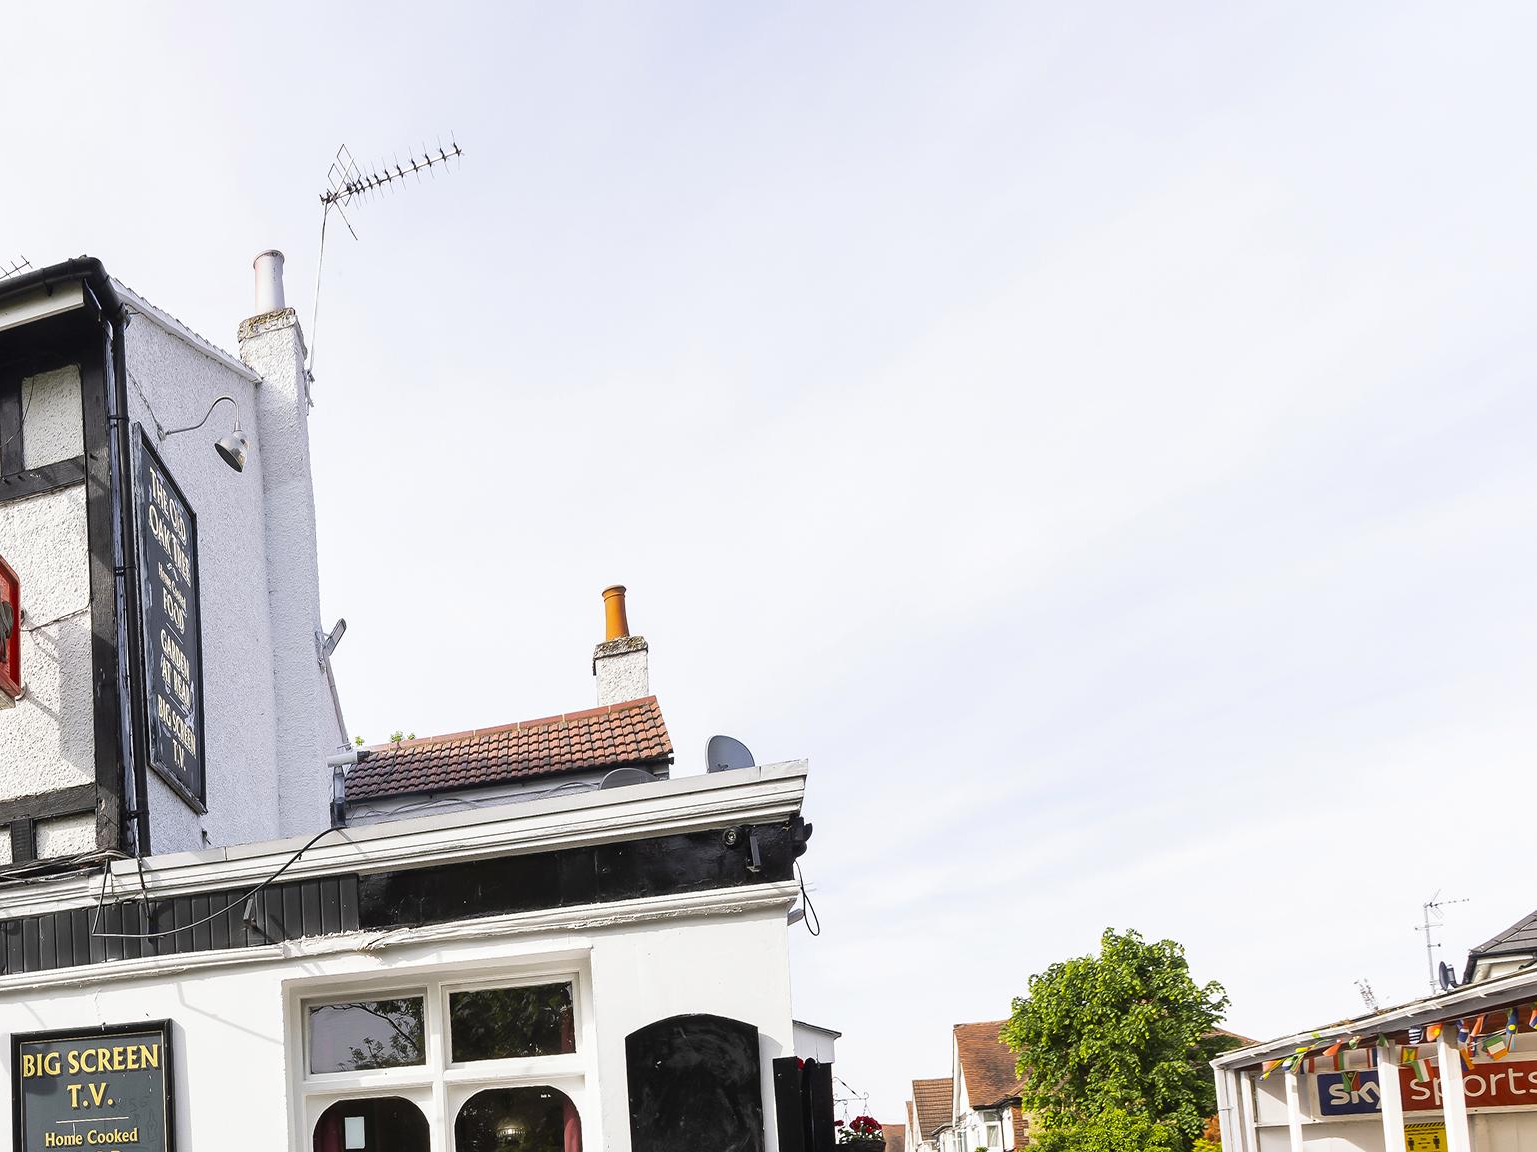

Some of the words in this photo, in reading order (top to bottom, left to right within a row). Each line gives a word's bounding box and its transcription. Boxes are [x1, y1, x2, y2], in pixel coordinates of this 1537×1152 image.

[149, 466, 169, 520] THE
[149, 504, 172, 558] OAK
[171, 532, 191, 587] TREE
[163, 586, 185, 634] FOOD
[160, 628, 190, 683] GARDEN
[161, 656, 172, 687] AT
[173, 668, 192, 710] REAR
[157, 693, 172, 730] BIG
[172, 709, 196, 758] SCREEN
[22, 1052, 61, 1078] BIG
[67, 1044, 159, 1074] SCREEN
[66, 1082, 114, 1108] T.V.
[45, 1131, 83, 1147] Home
[87, 1127, 138, 1144] Cooked
